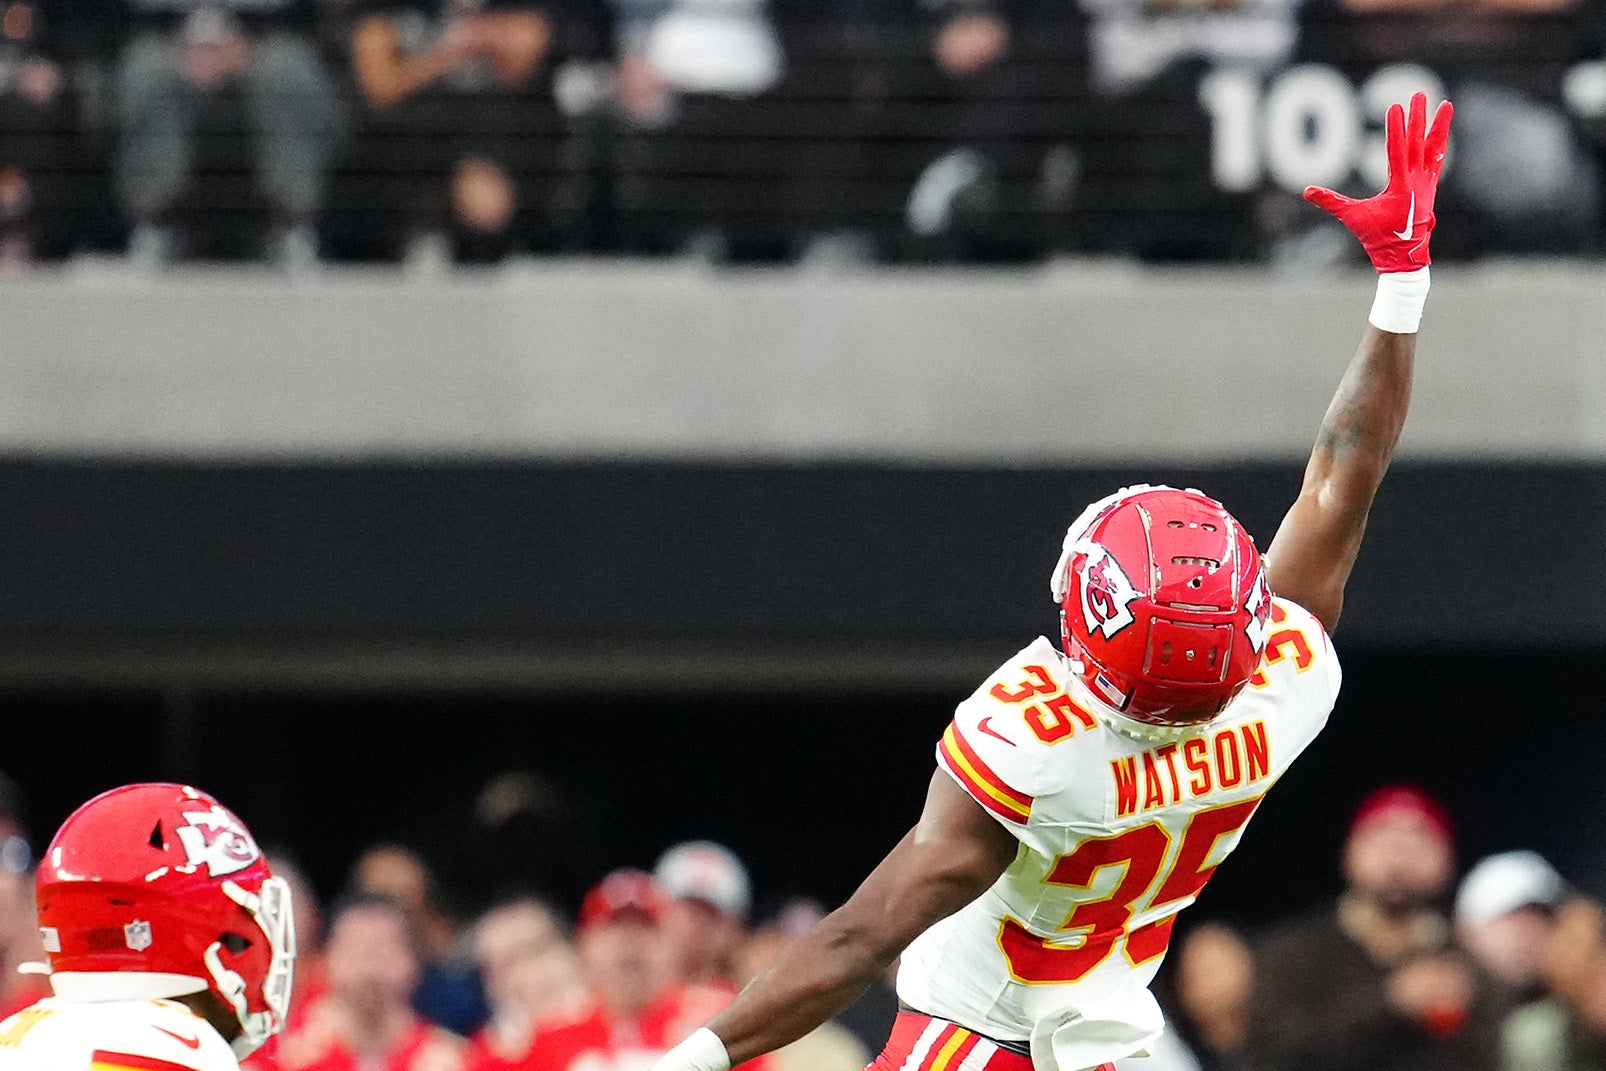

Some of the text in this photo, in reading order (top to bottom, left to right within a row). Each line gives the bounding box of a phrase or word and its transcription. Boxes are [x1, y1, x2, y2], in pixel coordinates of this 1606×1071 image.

[989, 664, 1098, 747] 35
[1110, 719, 1271, 818] WATSON
[996, 794, 1266, 985] 35
